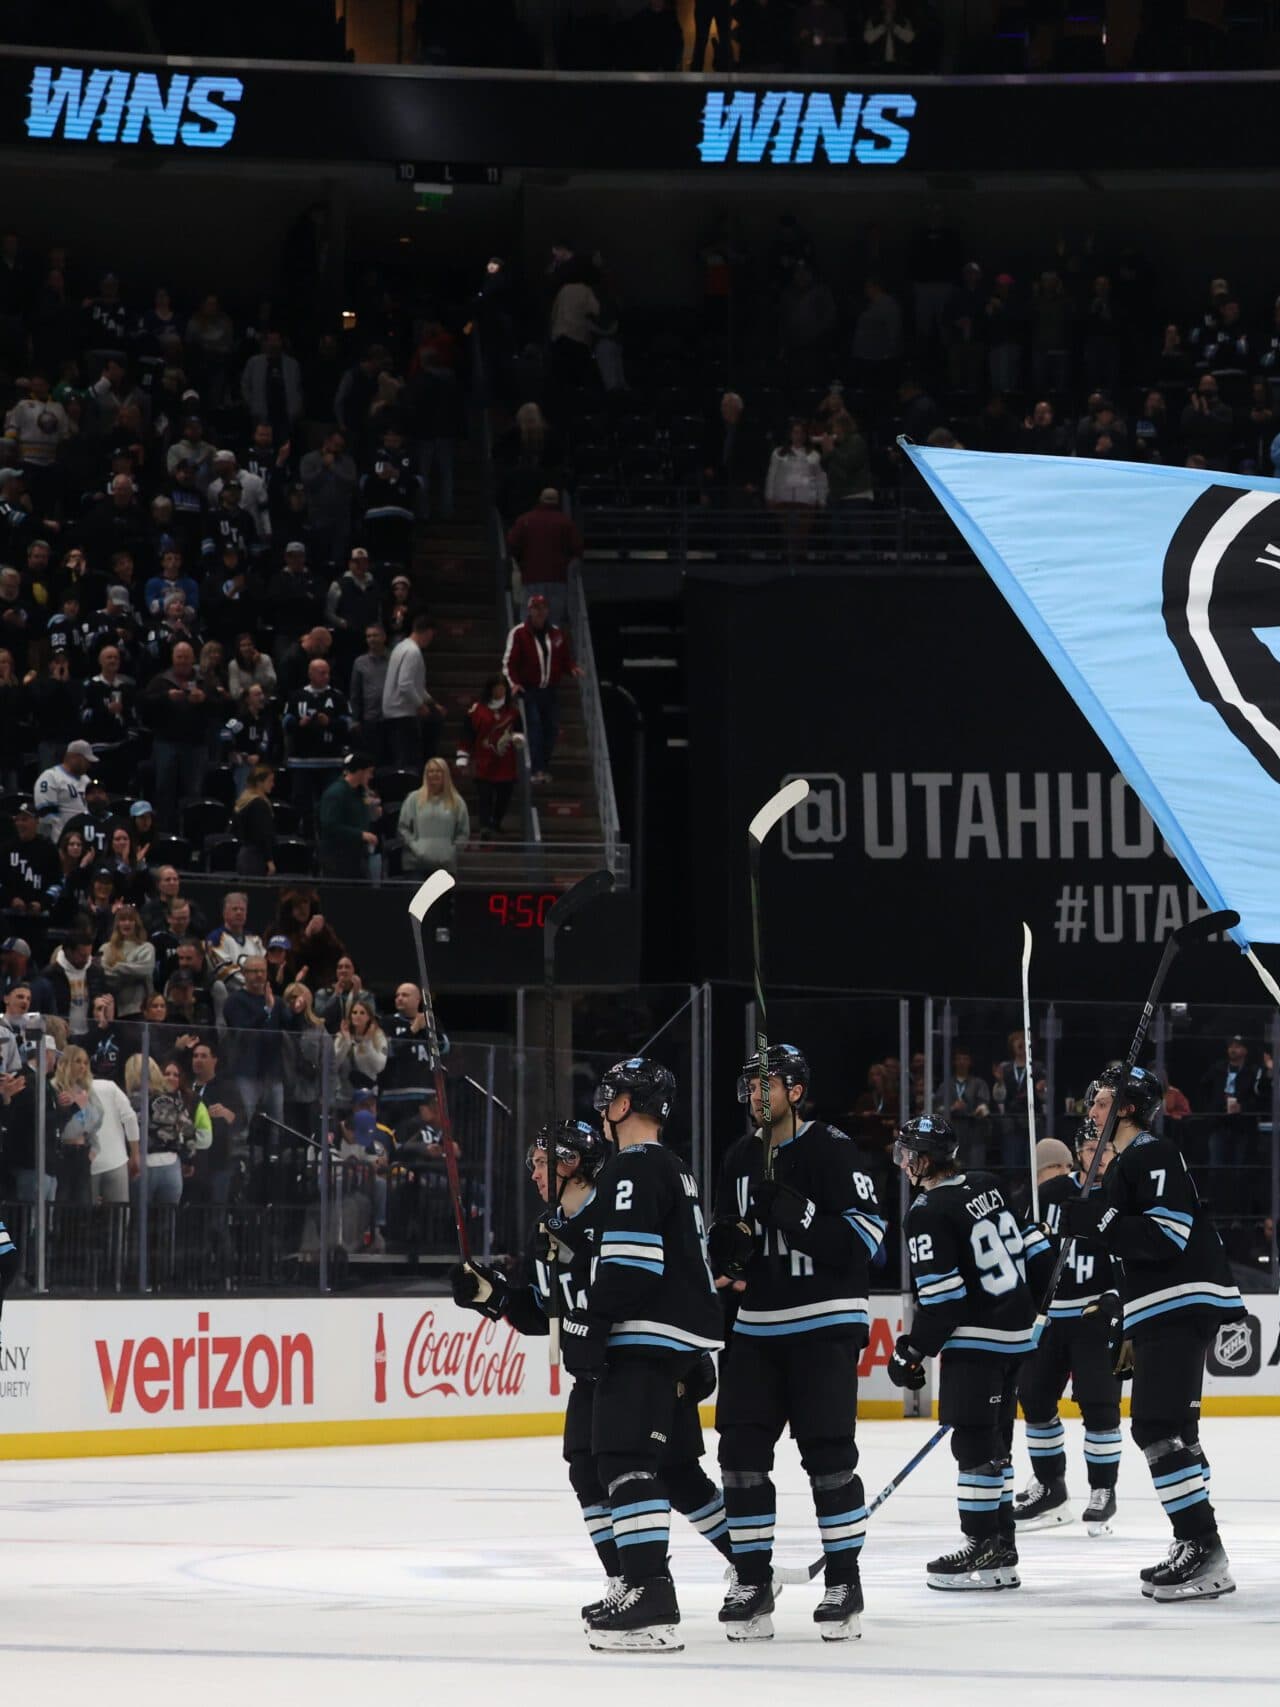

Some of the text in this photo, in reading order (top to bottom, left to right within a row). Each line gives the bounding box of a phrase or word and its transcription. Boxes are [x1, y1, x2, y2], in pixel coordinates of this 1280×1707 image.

[25, 66, 244, 147] WINS
[697, 91, 917, 164] WINS
[781, 772, 1178, 860] @UTAHHO
[10, 852, 42, 889] UTAH
[615, 1179, 634, 1211] 2
[1149, 1168, 1166, 1197] 7
[965, 1188, 1005, 1220] COOLEY
[907, 1233, 934, 1263] 92
[95, 1311, 315, 1414] verizon
